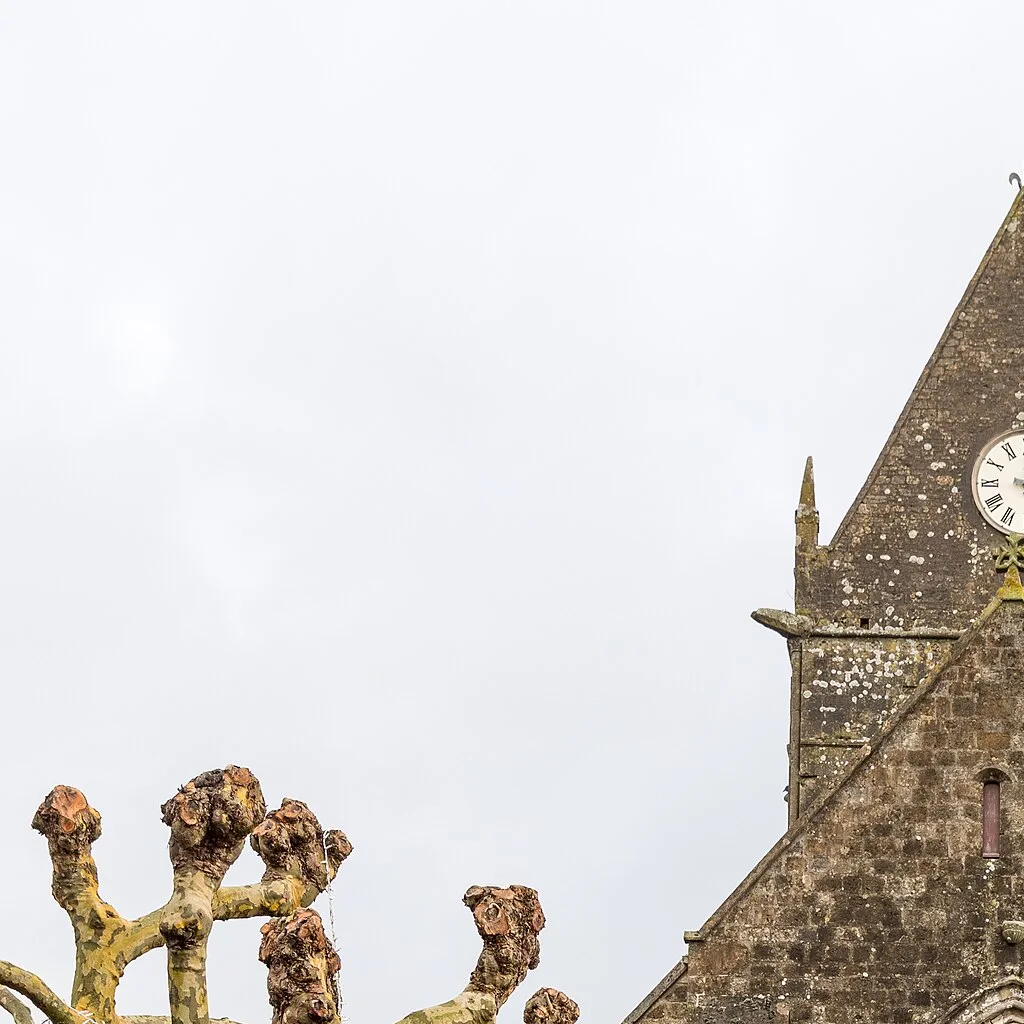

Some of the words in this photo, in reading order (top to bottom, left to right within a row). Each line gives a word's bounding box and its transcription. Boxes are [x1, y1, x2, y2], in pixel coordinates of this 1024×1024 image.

[1001, 442, 1017, 461] XI
[986, 458, 1004, 472] X
[981, 478, 999, 488] IX
[984, 493, 1004, 513] VIII
[1000, 506, 1016, 527] VII
